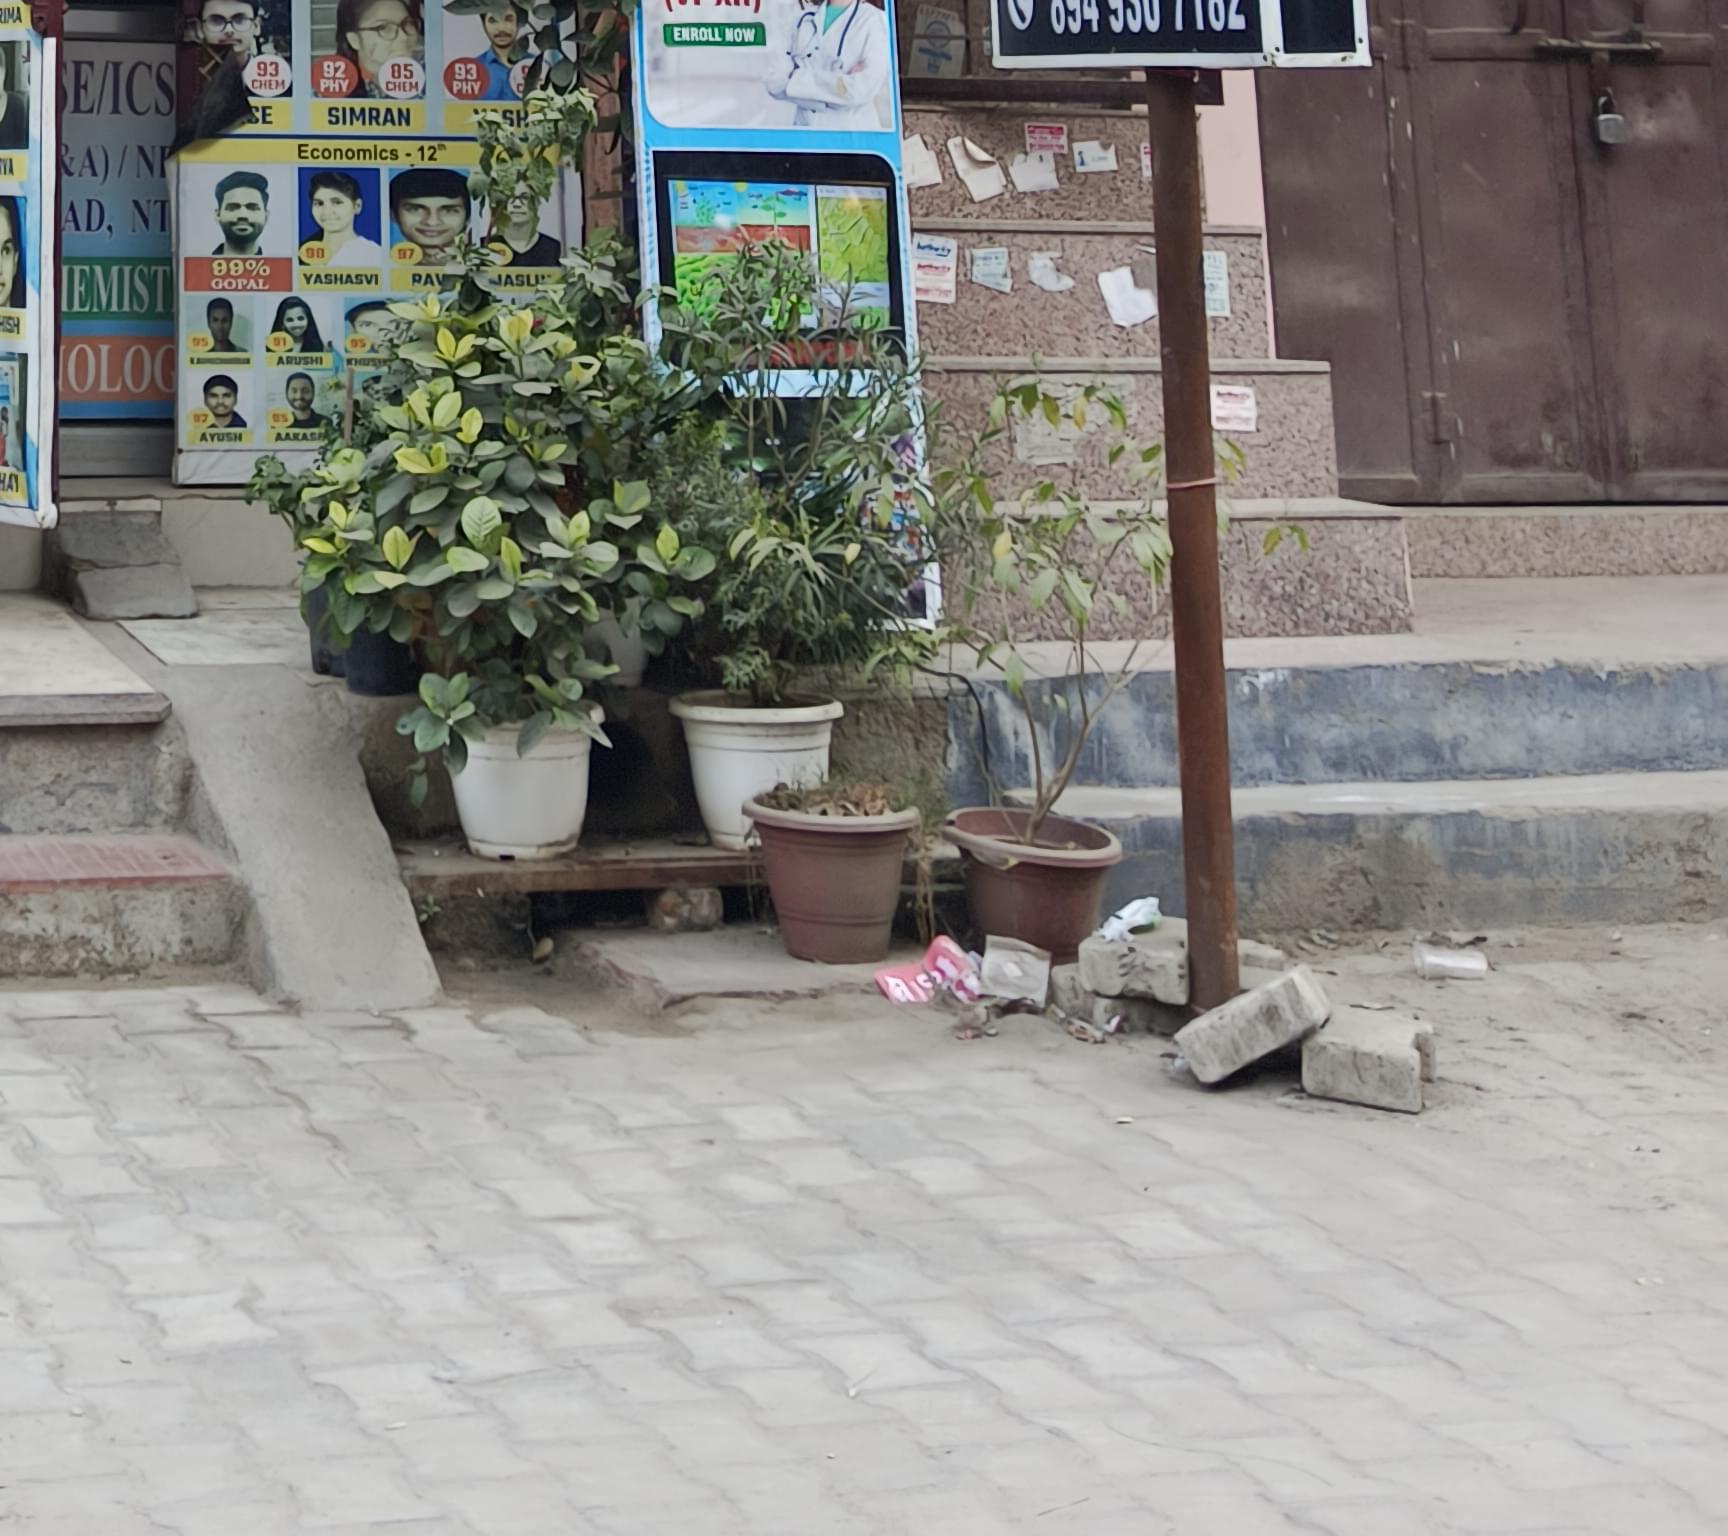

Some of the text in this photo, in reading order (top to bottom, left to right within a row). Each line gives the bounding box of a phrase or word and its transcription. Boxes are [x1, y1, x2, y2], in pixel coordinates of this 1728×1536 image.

[673, 26, 756, 43] ENROLL NOW
[255, 60, 280, 78] 93
[321, 61, 346, 79] 92
[453, 62, 478, 81] 93
[250, 77, 482, 96] CHEM PHY CHEM PHY
[326, 106, 412, 127] SIMRAN
[296, 142, 399, 162] Economics
[211, 258, 271, 277] 99%
[210, 273, 379, 291] GOPAL YASHASVI
[275, 355, 323, 367] ARUSHI
[199, 432, 243, 443] AYUSH
